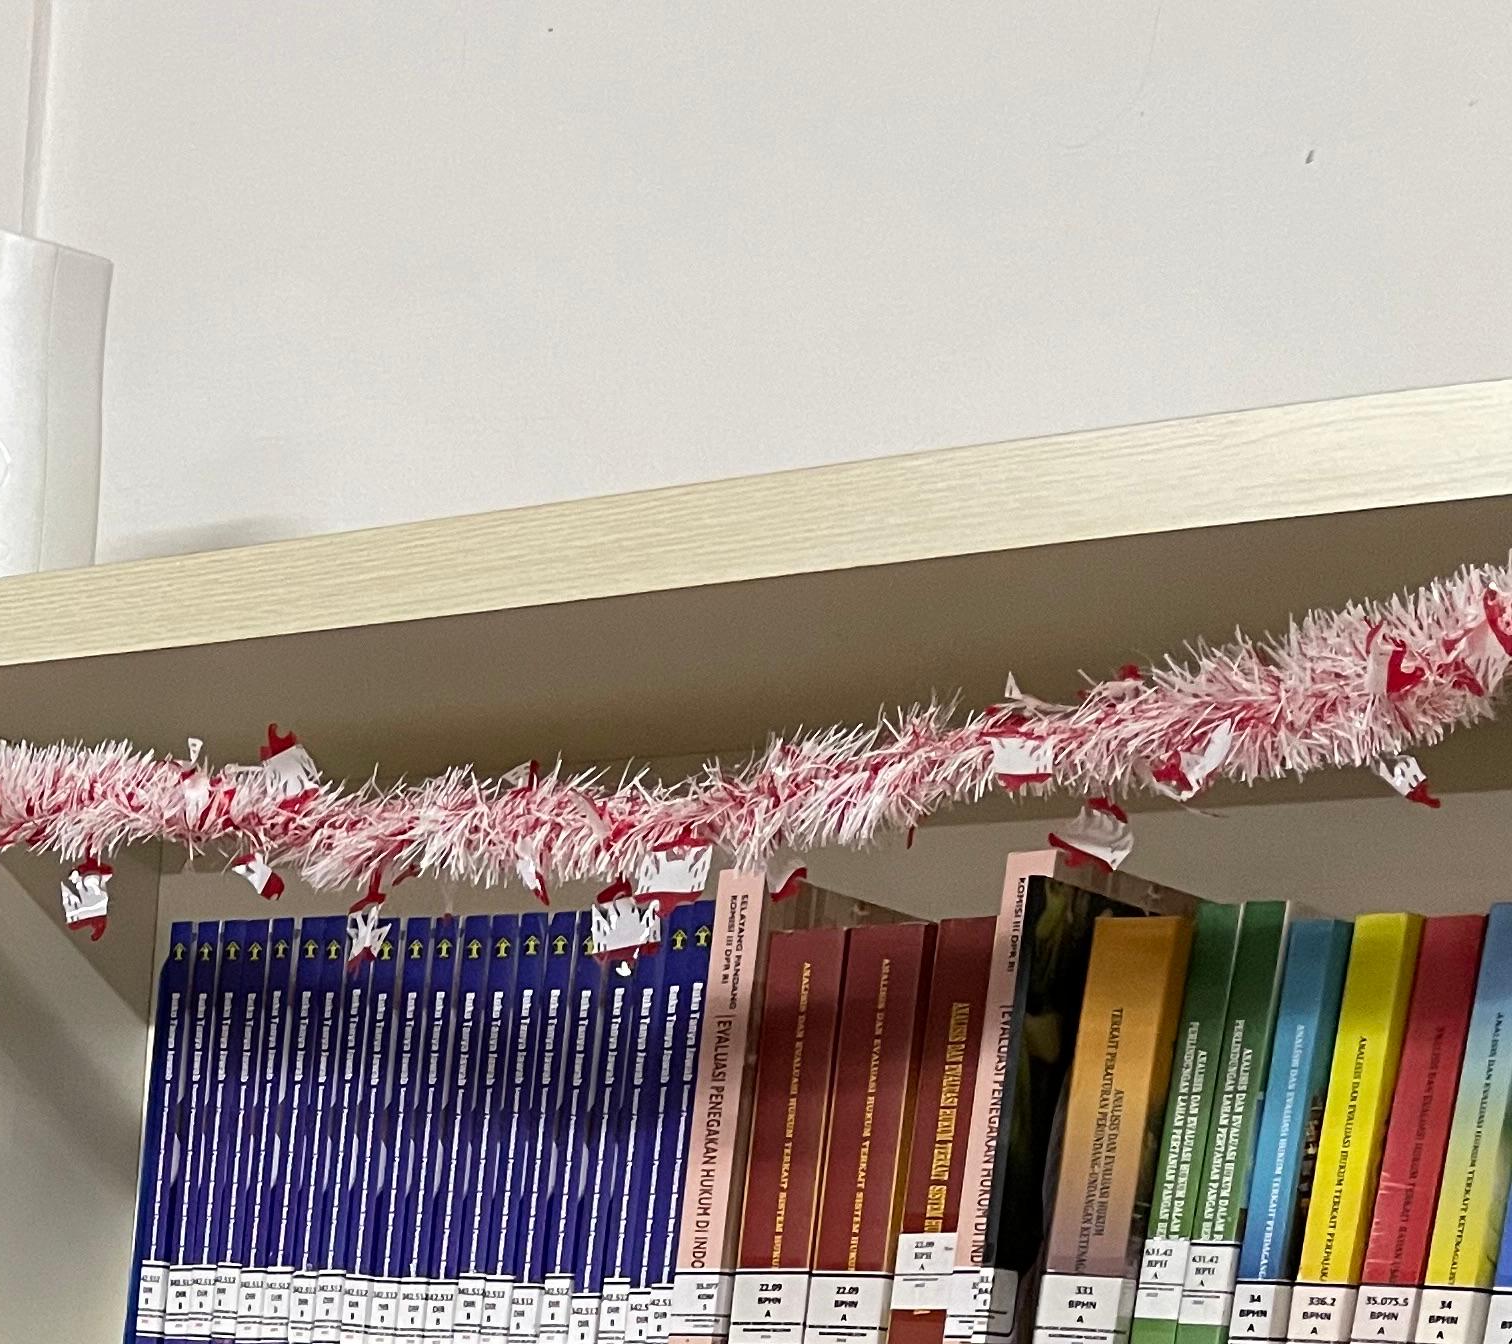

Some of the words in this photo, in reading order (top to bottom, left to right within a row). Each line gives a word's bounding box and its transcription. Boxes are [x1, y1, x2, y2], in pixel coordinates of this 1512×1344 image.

[711, 1020, 732, 1083] EVALUASI
[702, 1086, 725, 1166] PENEGAKAN
[696, 1169, 716, 1218] HUKUM
[695, 1221, 710, 1235] DI
[1308, 1297, 1335, 1306] 336.2
